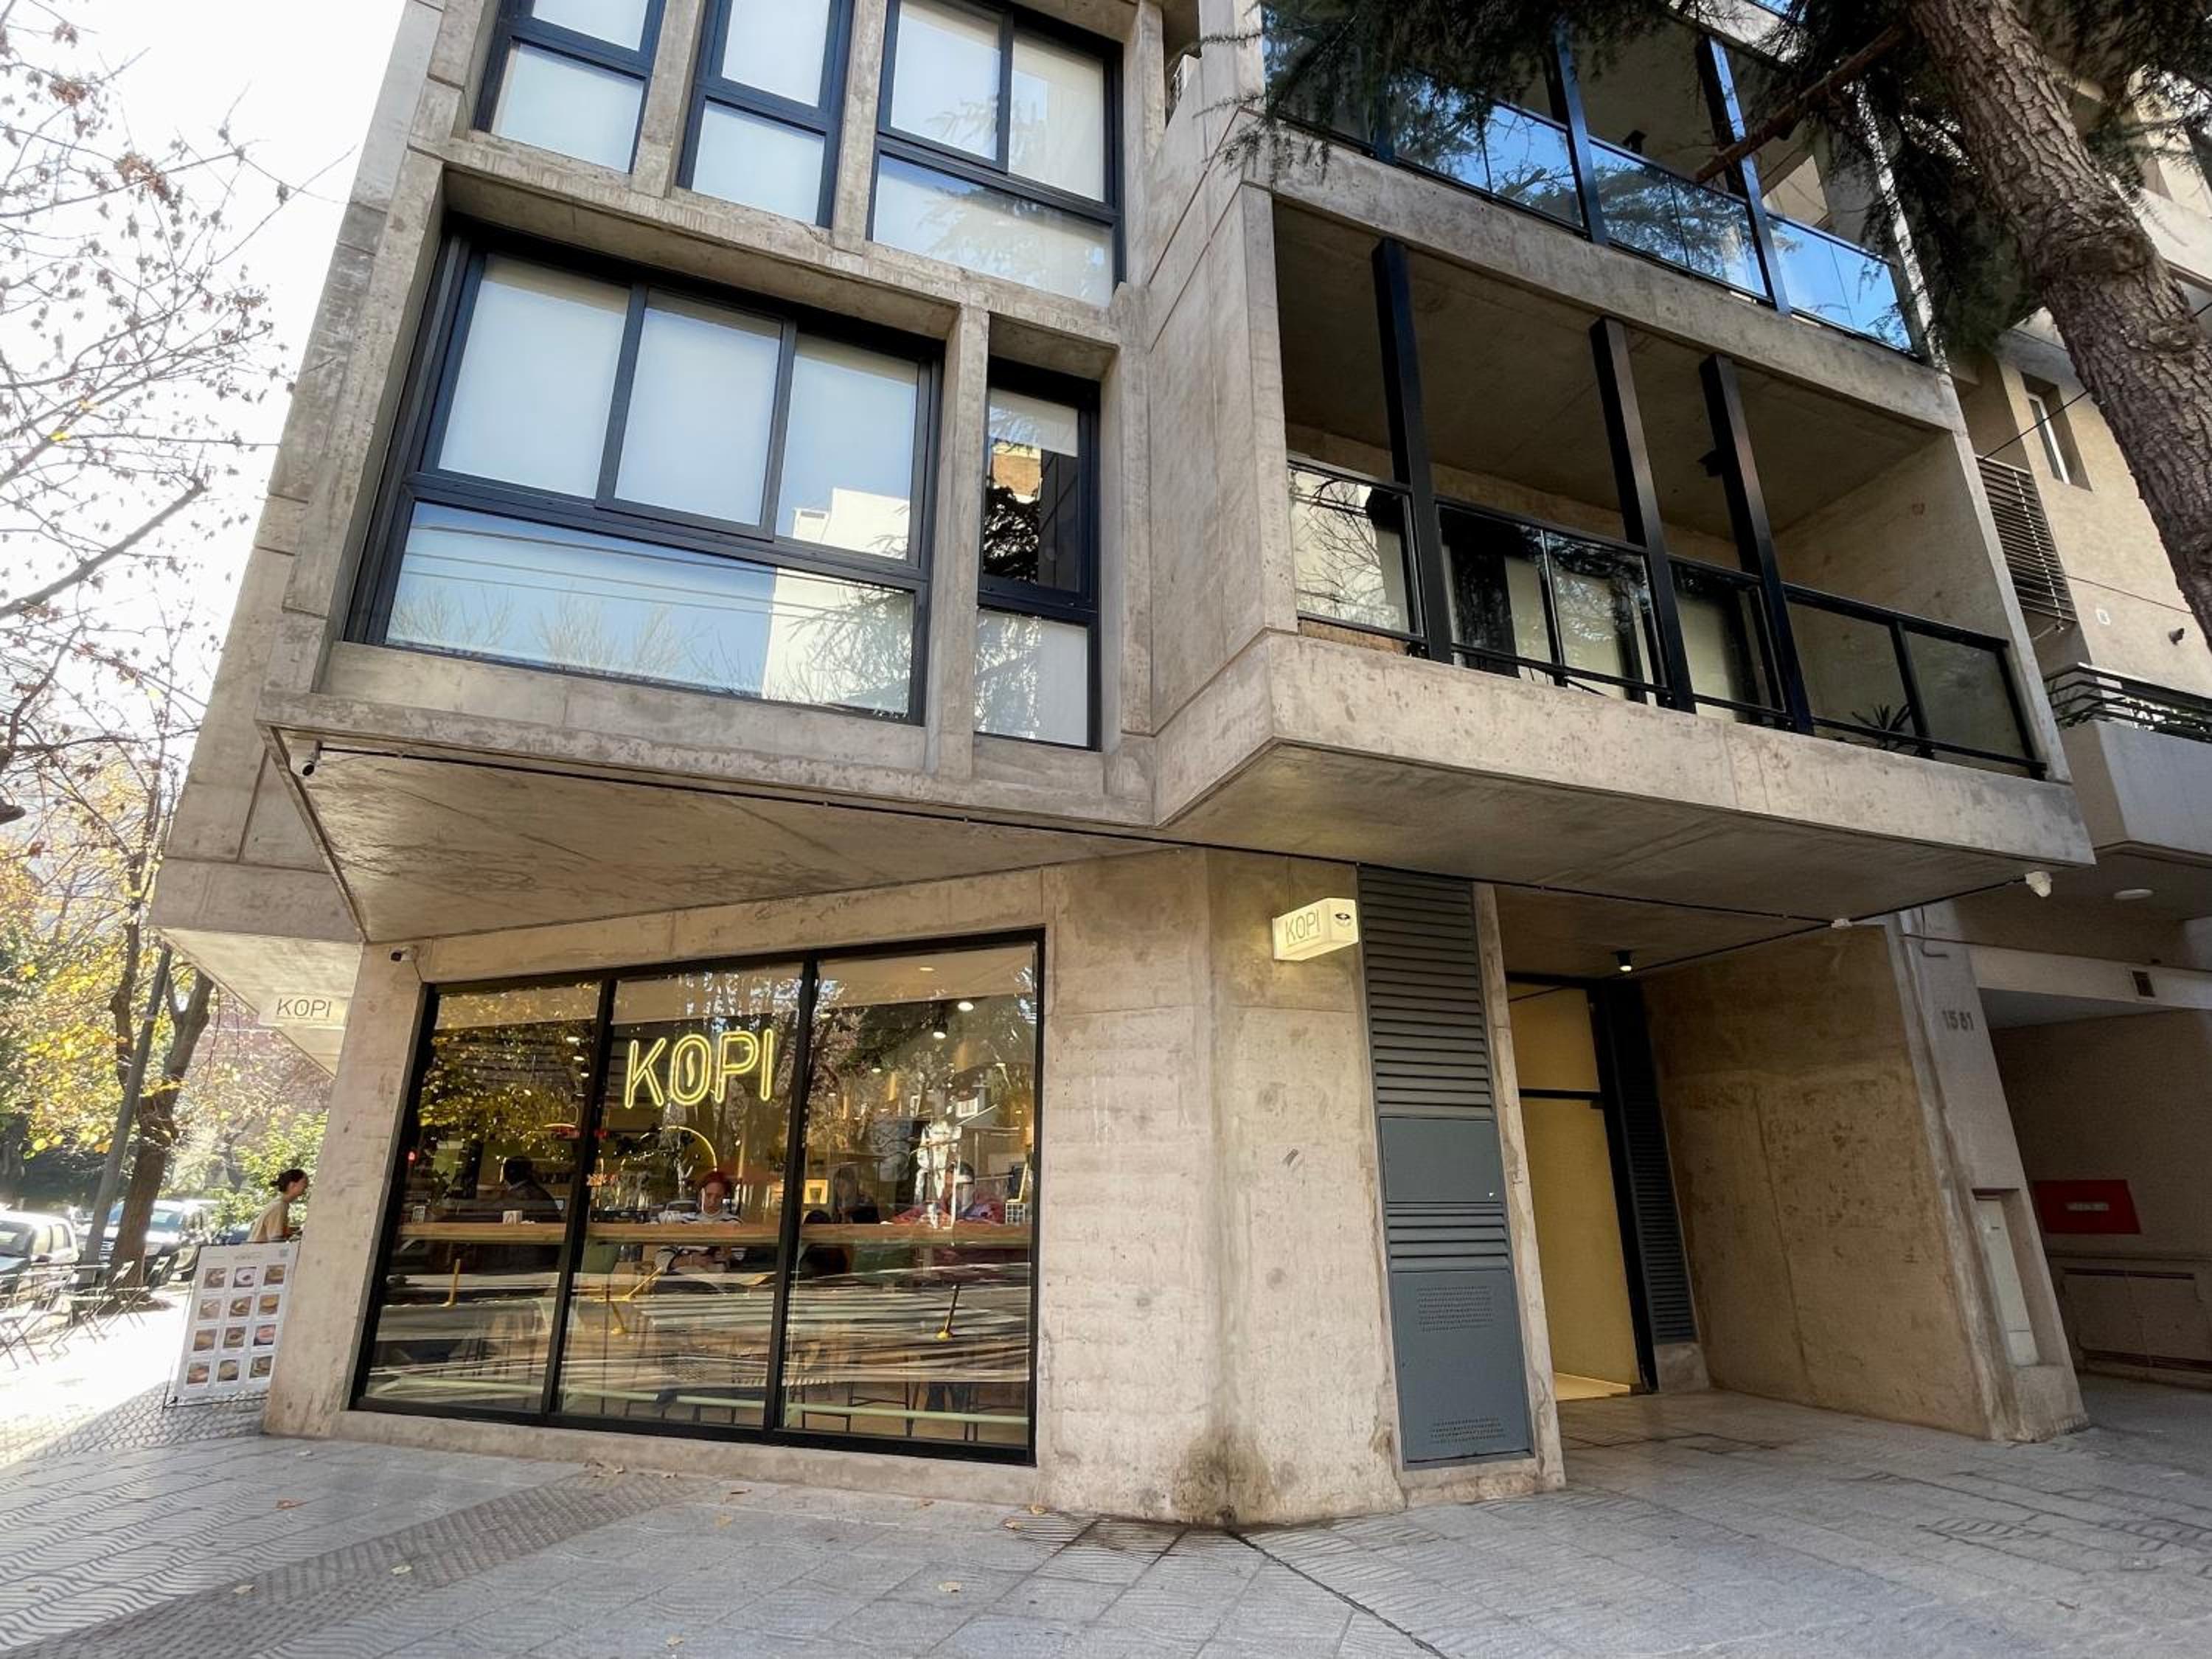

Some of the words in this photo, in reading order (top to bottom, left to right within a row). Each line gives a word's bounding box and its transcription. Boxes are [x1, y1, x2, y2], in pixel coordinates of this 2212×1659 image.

[1285, 908, 1321, 945] KOPI
[276, 998, 332, 1018] KOPI
[625, 1029, 773, 1109] KOPI
